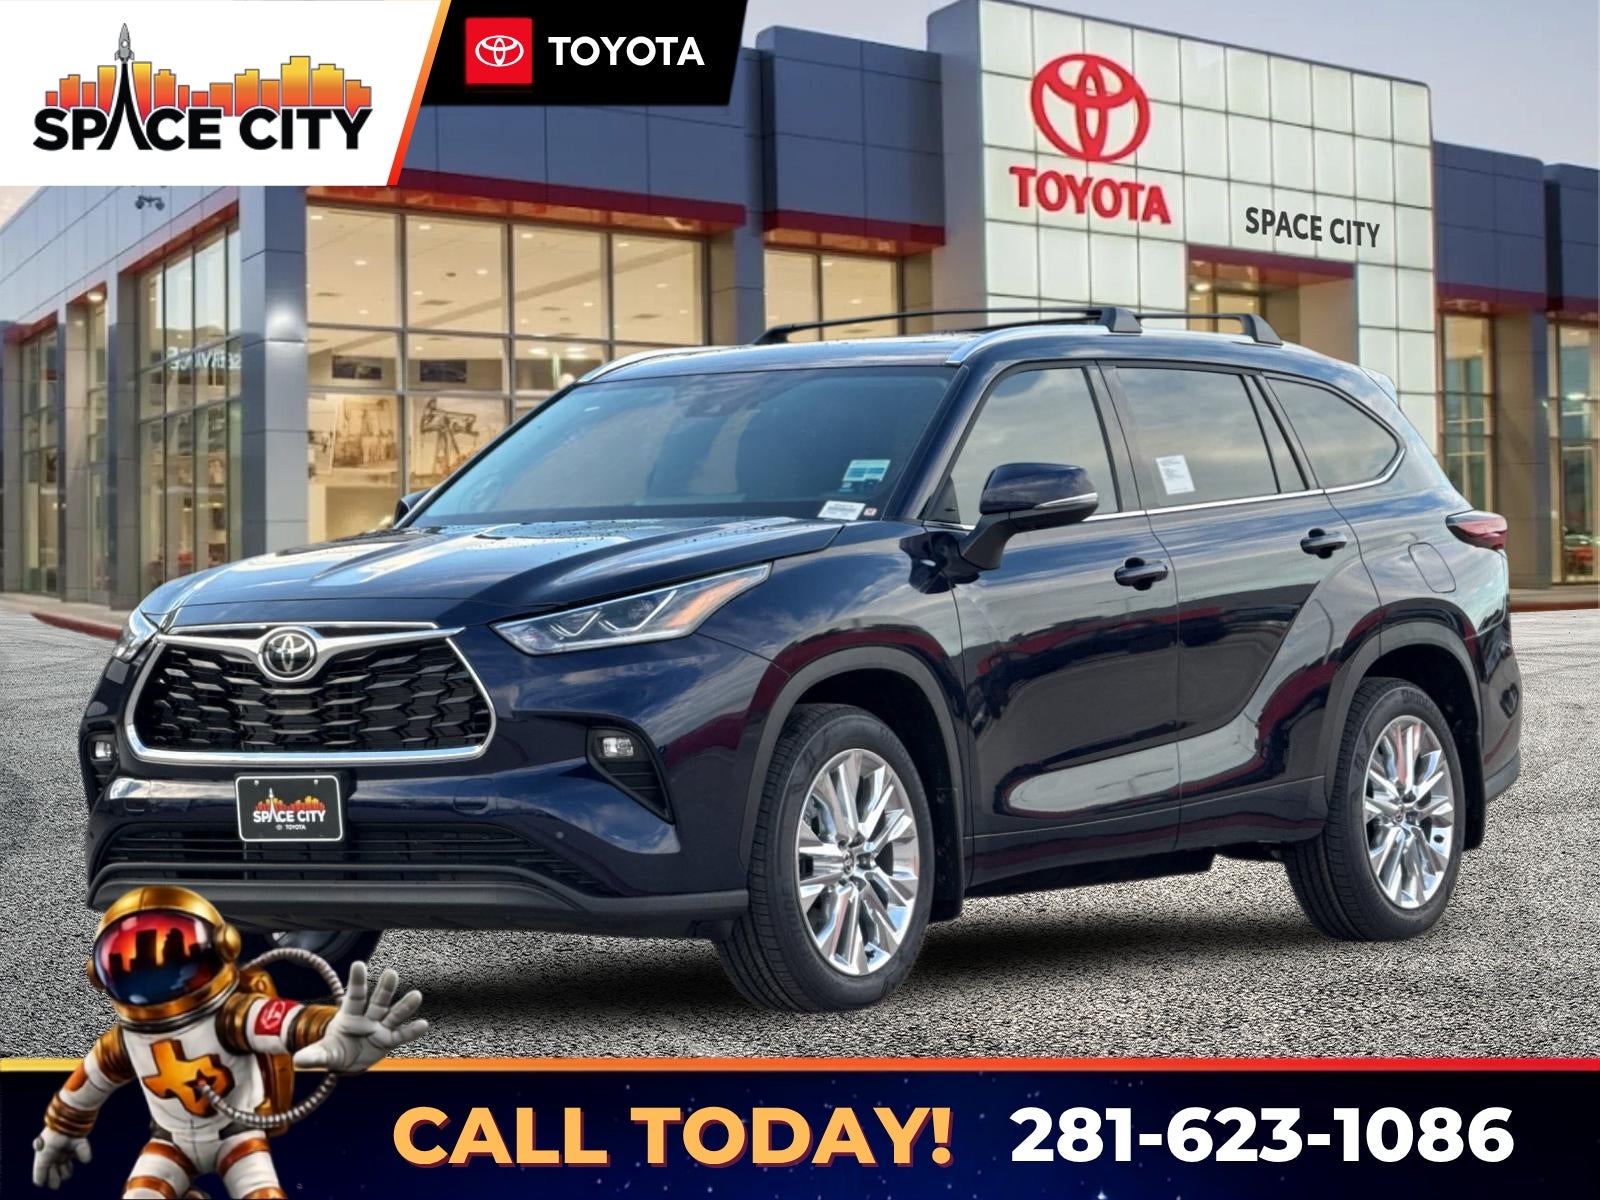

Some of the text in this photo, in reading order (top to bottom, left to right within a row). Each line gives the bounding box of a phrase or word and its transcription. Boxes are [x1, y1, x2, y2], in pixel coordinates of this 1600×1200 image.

[1009, 166, 1171, 224] TOYOTA
[1245, 206, 1381, 248] SPACE CITY
[253, 809, 326, 822] SPACE CITY
